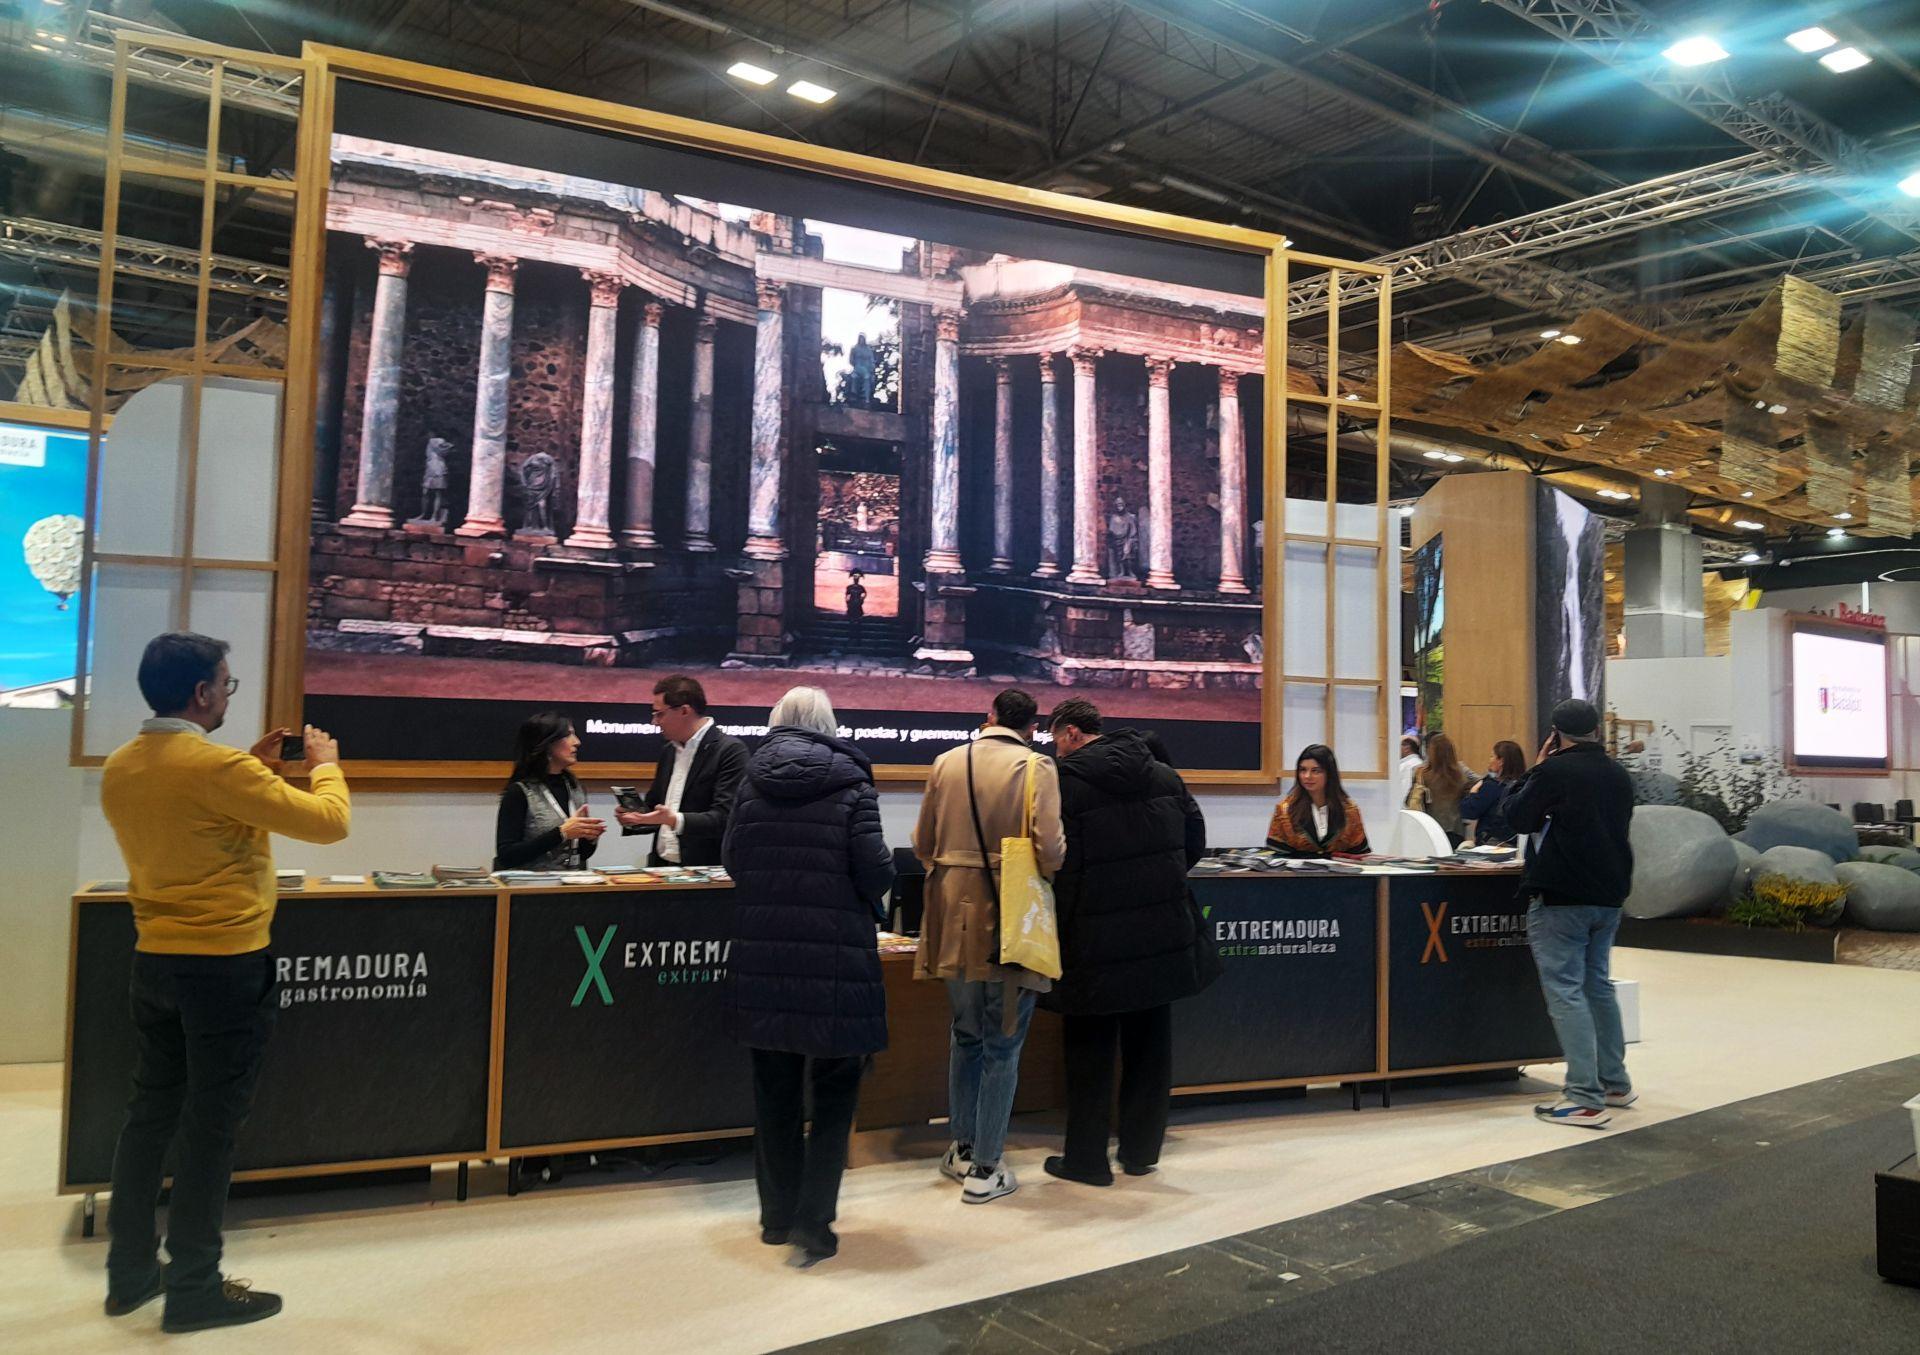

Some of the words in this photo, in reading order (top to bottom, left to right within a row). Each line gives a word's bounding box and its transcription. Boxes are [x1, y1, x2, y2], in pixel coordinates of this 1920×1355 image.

[586, 719, 662, 734] Monumen
[836, 725, 853, 738] de
[854, 727, 899, 740] poetas
[900, 729, 907, 742] y
[910, 729, 970, 742] guerreros
[970, 728, 981, 741] d
[1215, 919, 1340, 941] EXTREMADURA
[1450, 914, 1527, 934] EXTREMAD
[624, 940, 732, 968] EXTREM
[1218, 940, 1337, 956] extranaturaleza
[276, 952, 428, 982] REMADURA
[657, 968, 728, 985] extrar
[279, 978, 428, 1009] gastronomía
